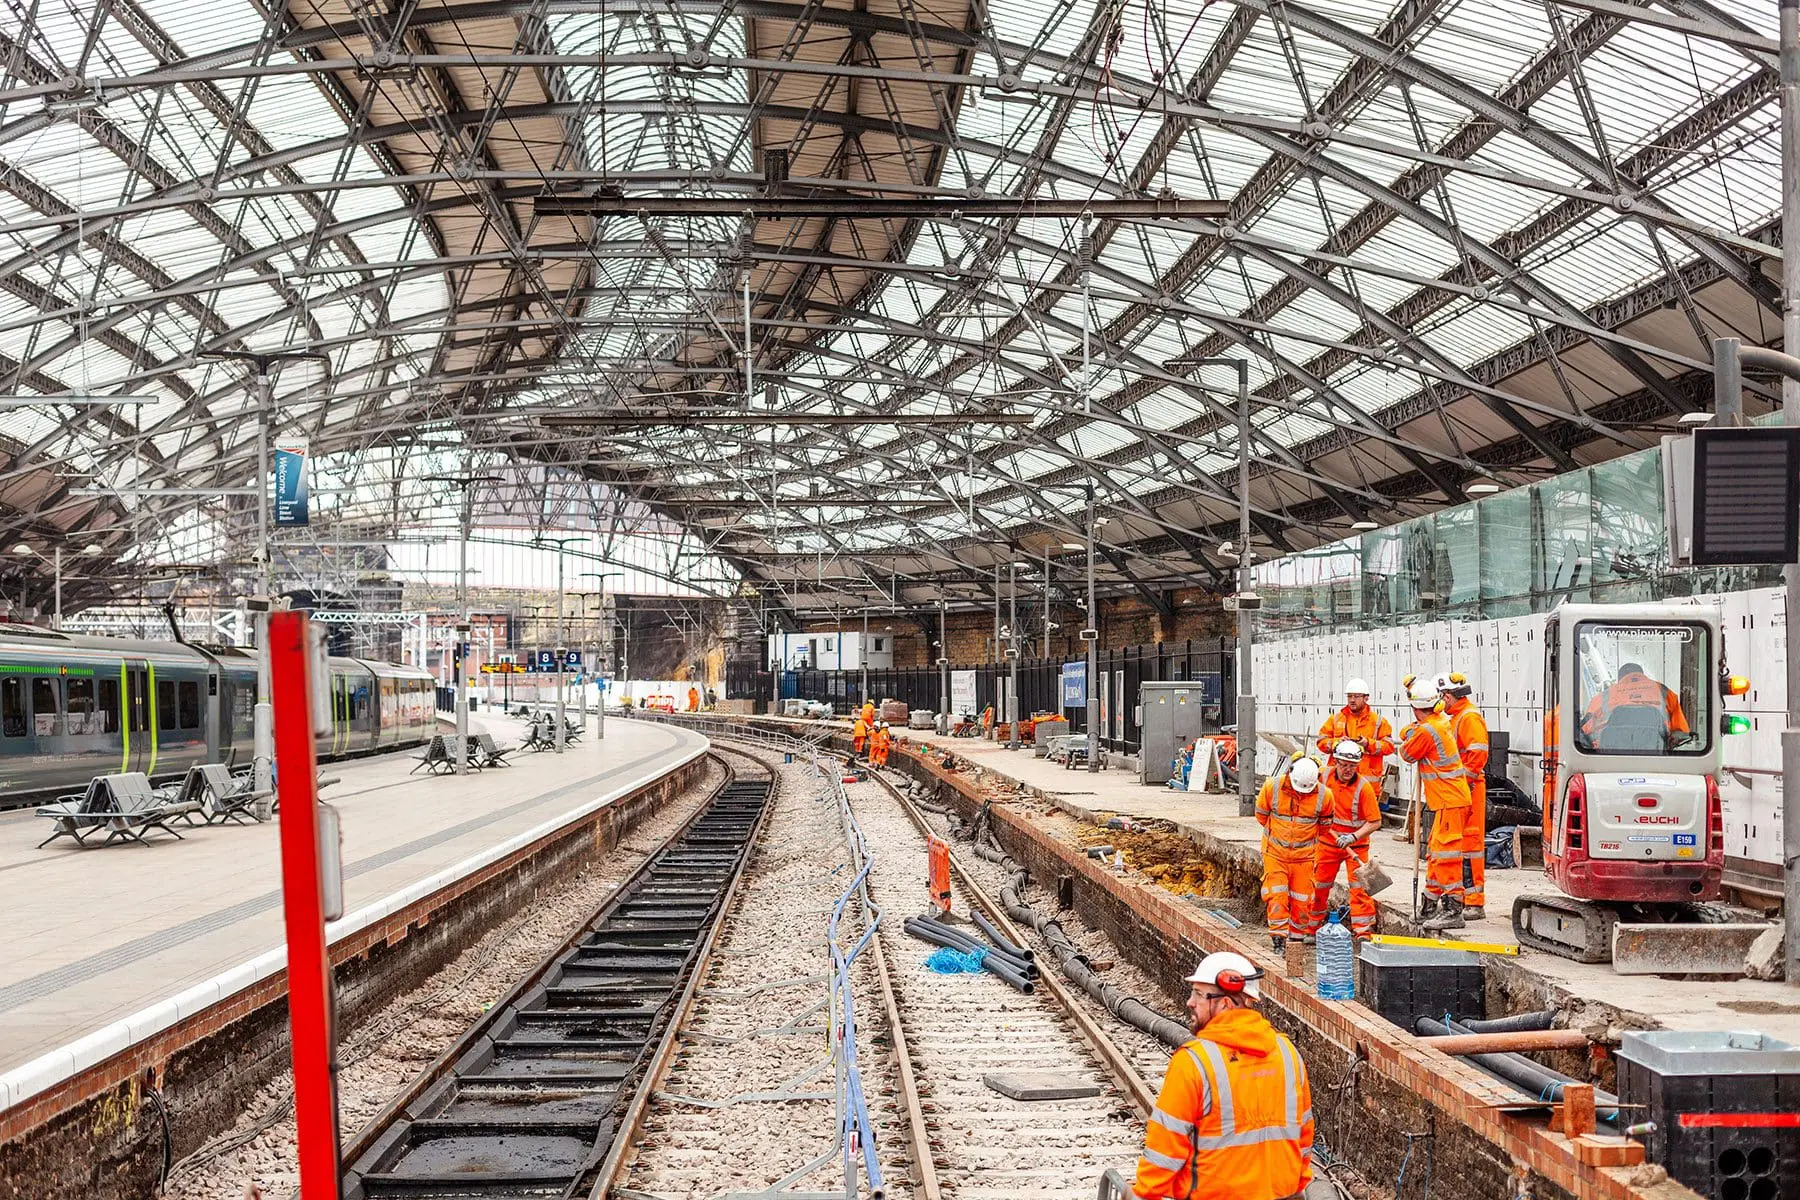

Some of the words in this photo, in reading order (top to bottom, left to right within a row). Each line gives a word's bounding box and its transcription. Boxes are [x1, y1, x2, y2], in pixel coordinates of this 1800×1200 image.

[279, 457, 288, 494] Welcome
[542, 653, 550, 663] 8
[569, 653, 577, 663] 9
[1614, 815, 1679, 825] TEUCHI
